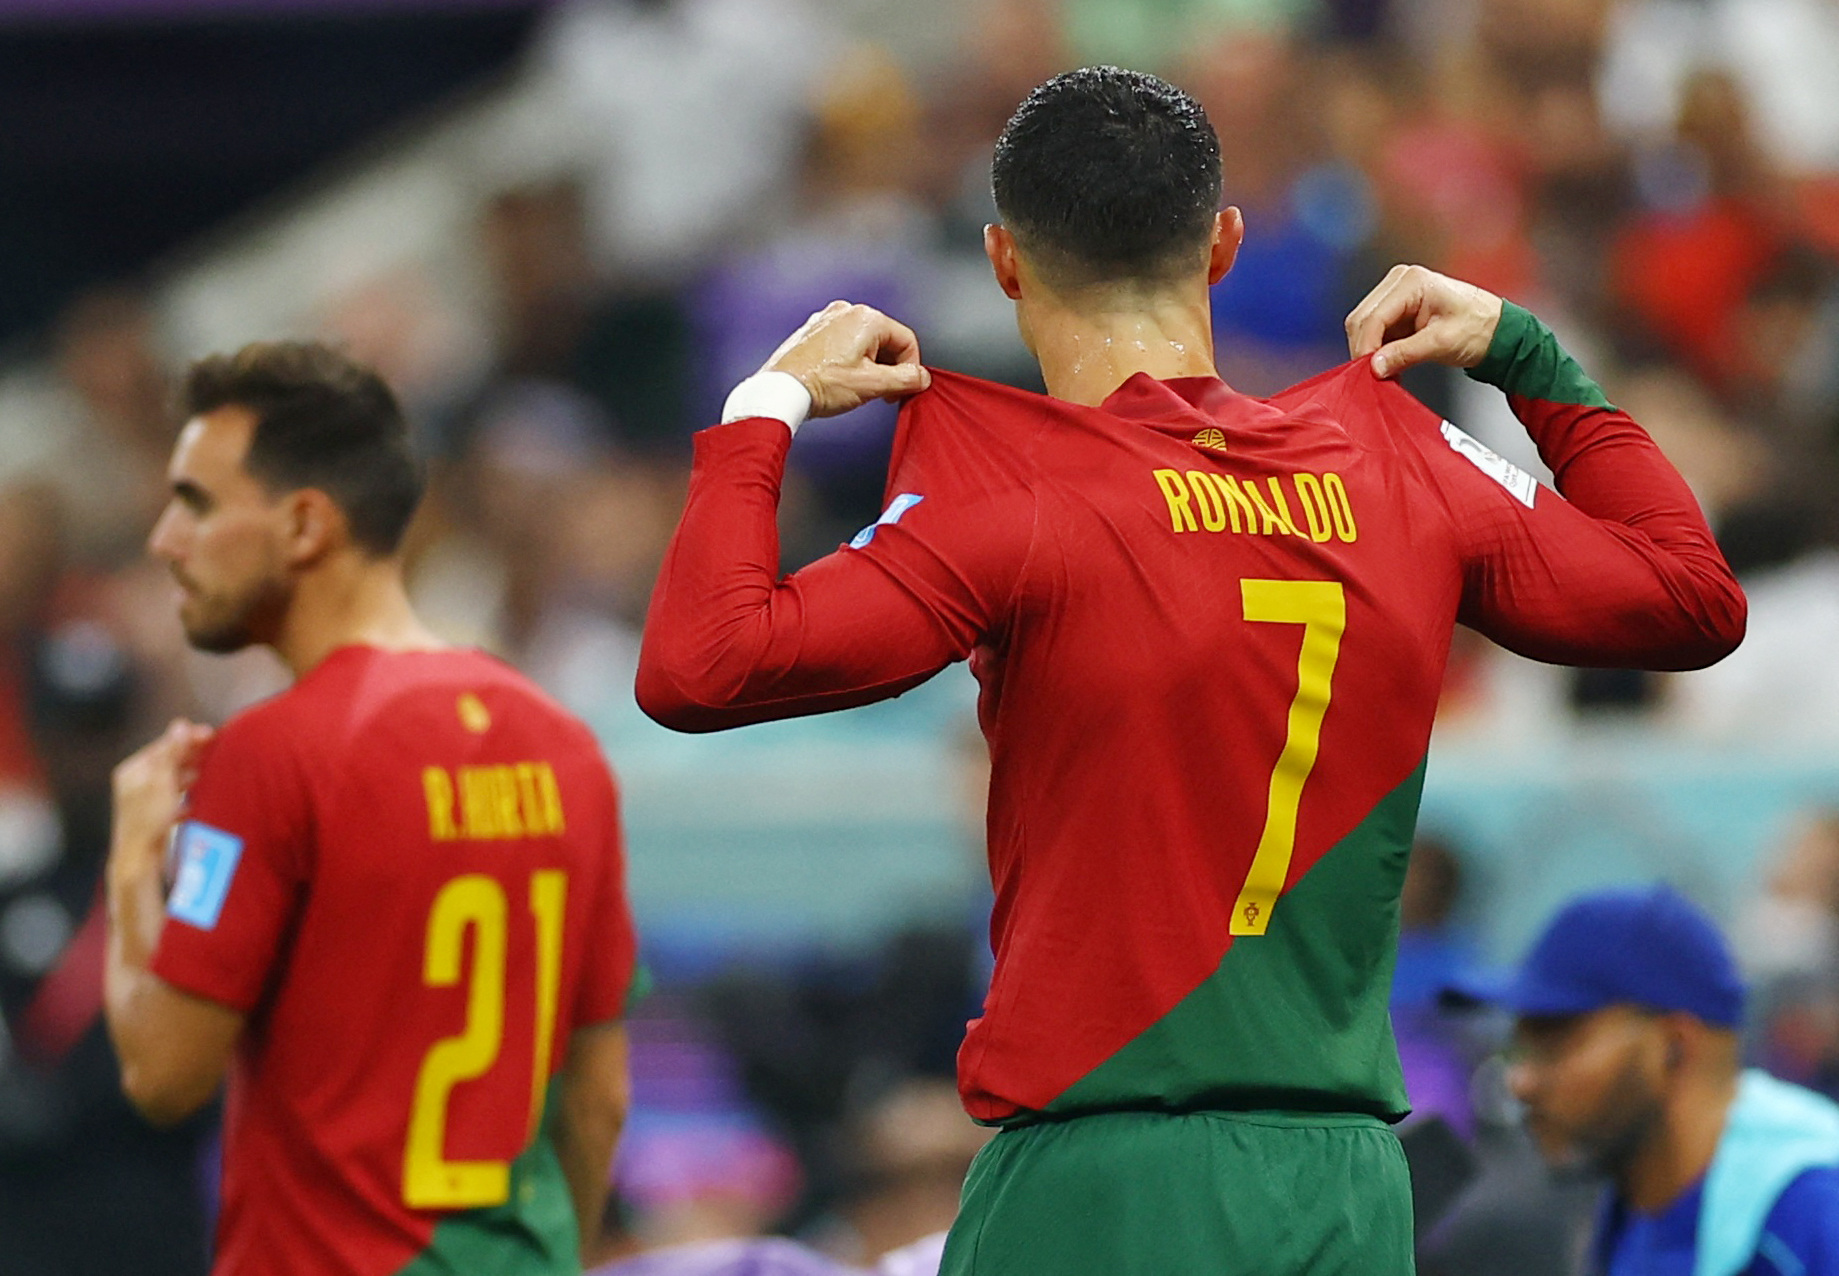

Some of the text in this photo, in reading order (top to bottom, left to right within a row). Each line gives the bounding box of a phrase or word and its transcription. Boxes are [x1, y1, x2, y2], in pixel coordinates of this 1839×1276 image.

[1153, 469, 1357, 543] RONALDO
[1229, 578, 1346, 936] 7
[403, 869, 567, 1208] 21
